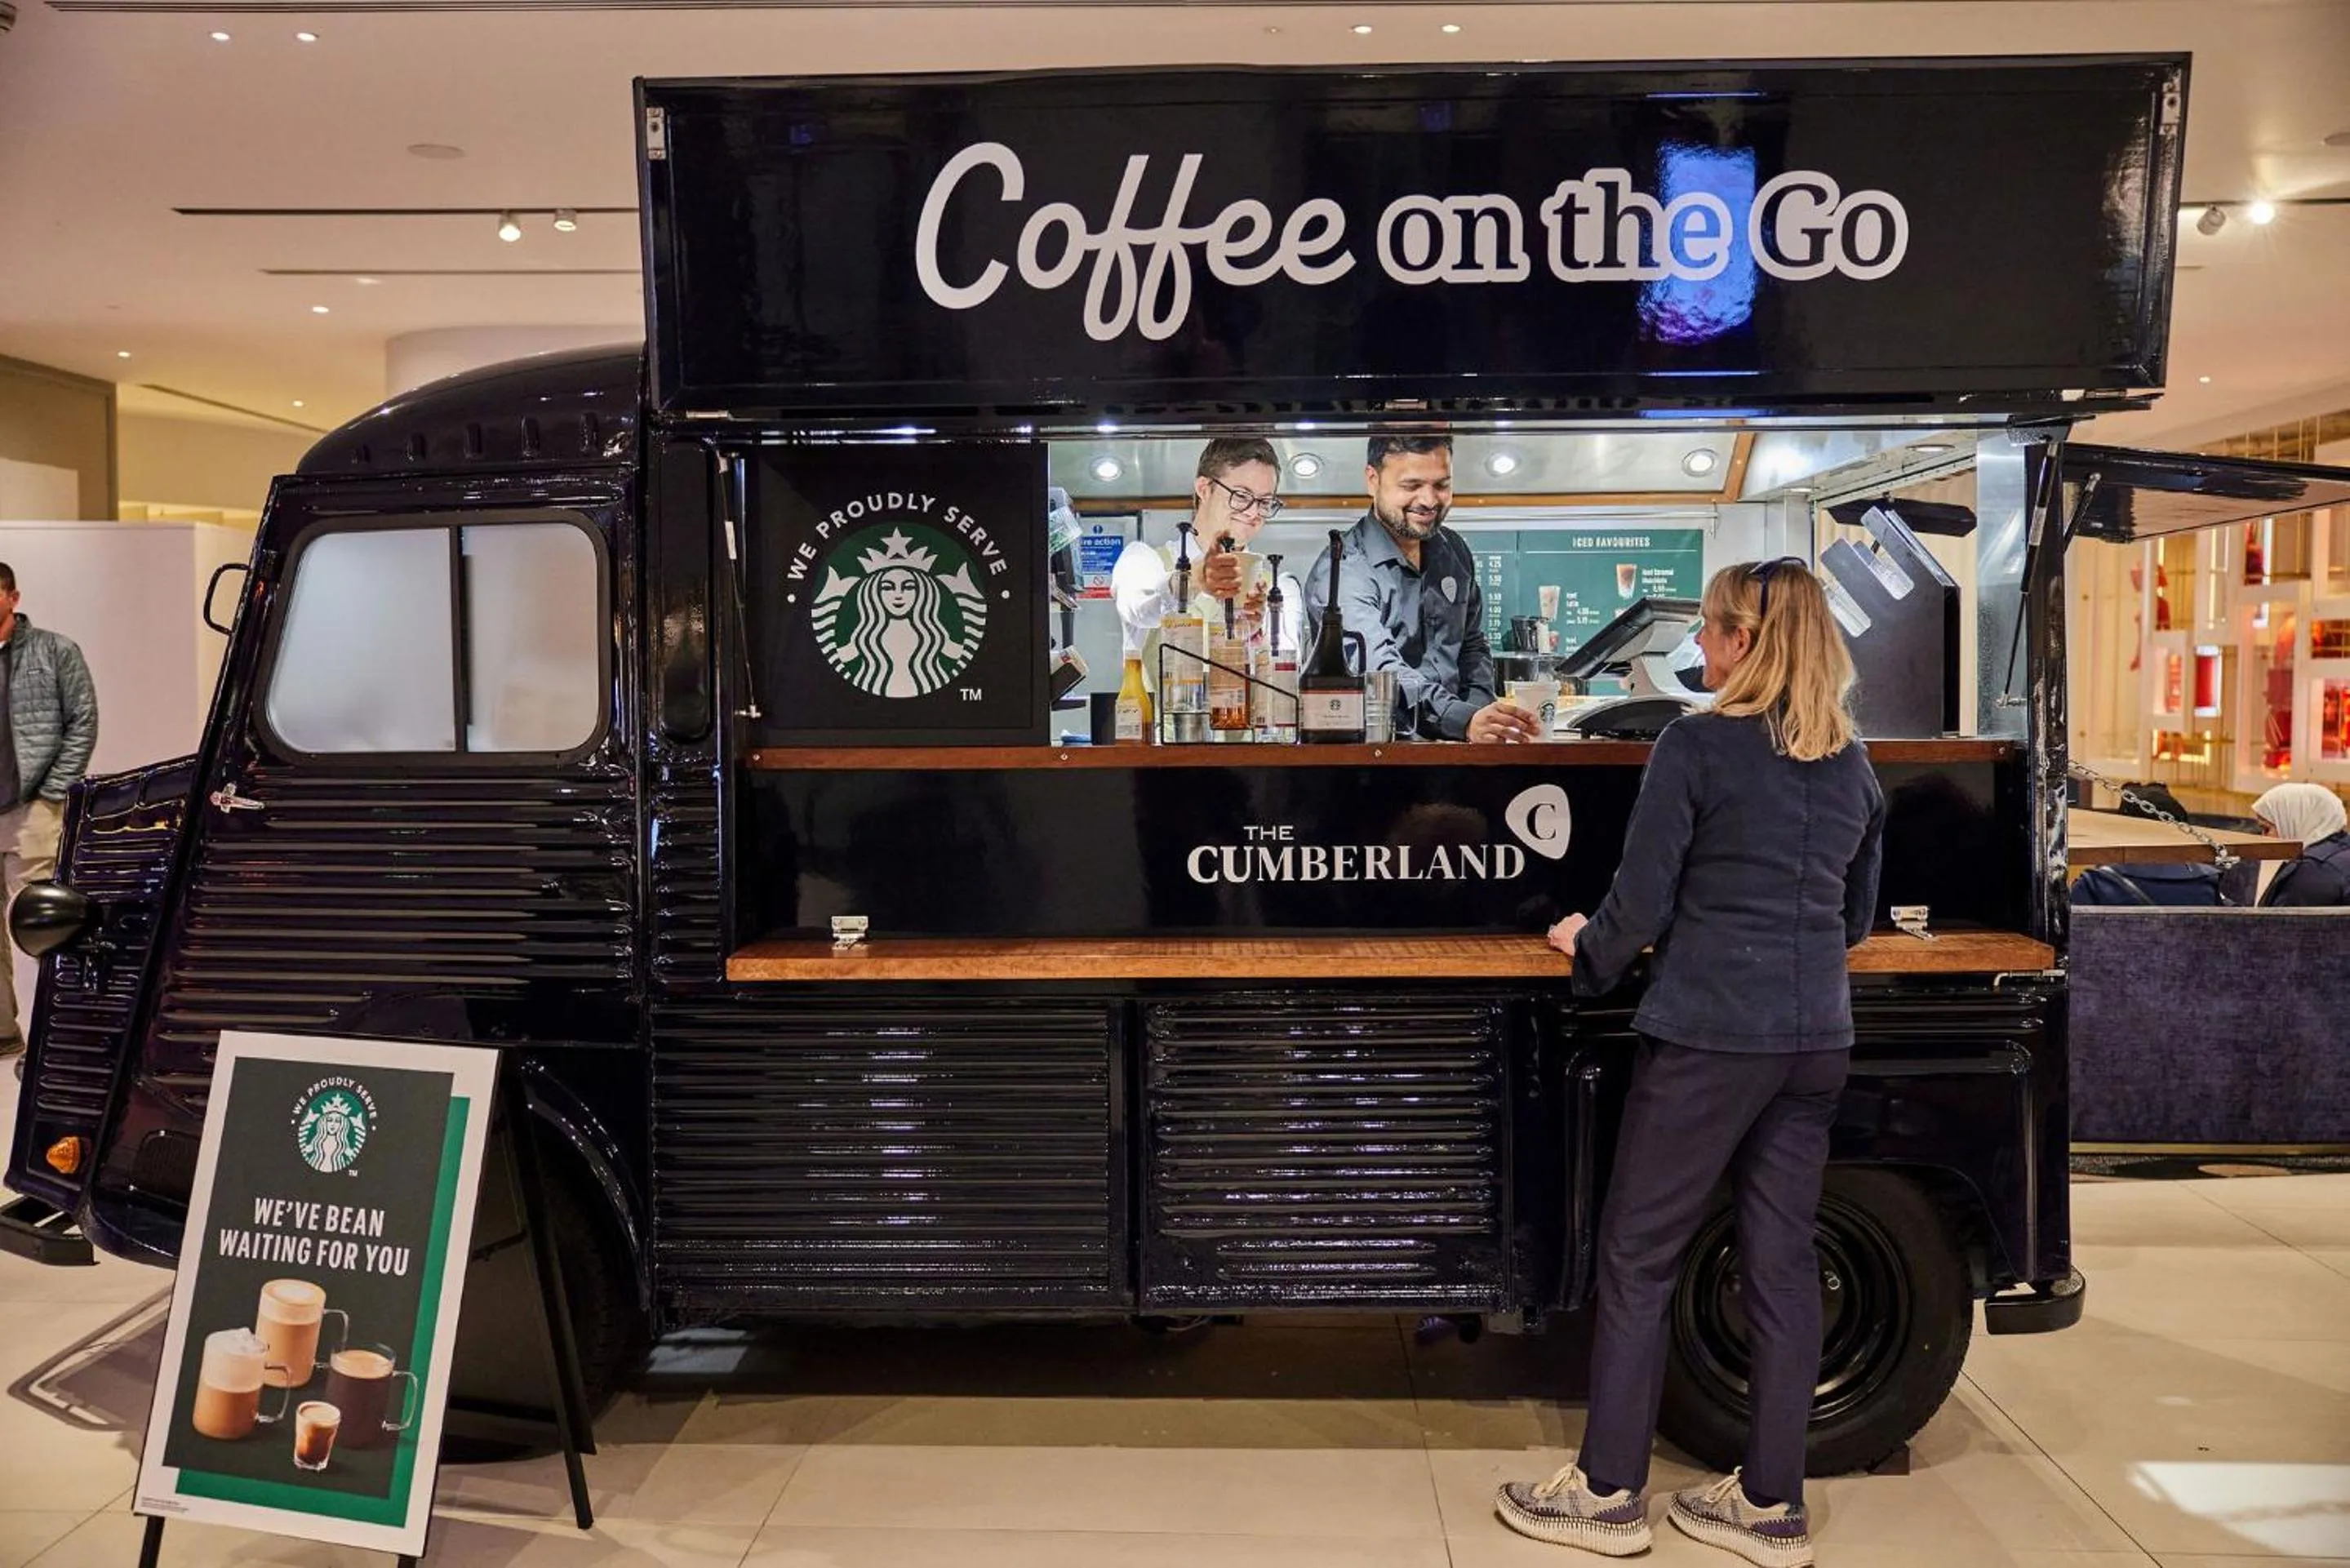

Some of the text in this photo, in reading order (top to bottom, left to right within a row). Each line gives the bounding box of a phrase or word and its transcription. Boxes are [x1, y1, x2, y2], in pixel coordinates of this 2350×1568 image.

[915, 142, 1910, 341] Coffee on the Go
[787, 492, 1009, 581] WE PROUDLY SERVE
[1572, 536, 1651, 549] ICED FAVOURITES
[959, 688, 983, 701] TM
[1243, 825, 1295, 841] THE
[1187, 843, 1526, 883] CUMBERLAND
[292, 1077, 378, 1120] WE PROUDLY SERVE
[254, 1197, 385, 1238] WE’VE BEAN
[219, 1228, 411, 1277] WAITING FOR YOU
